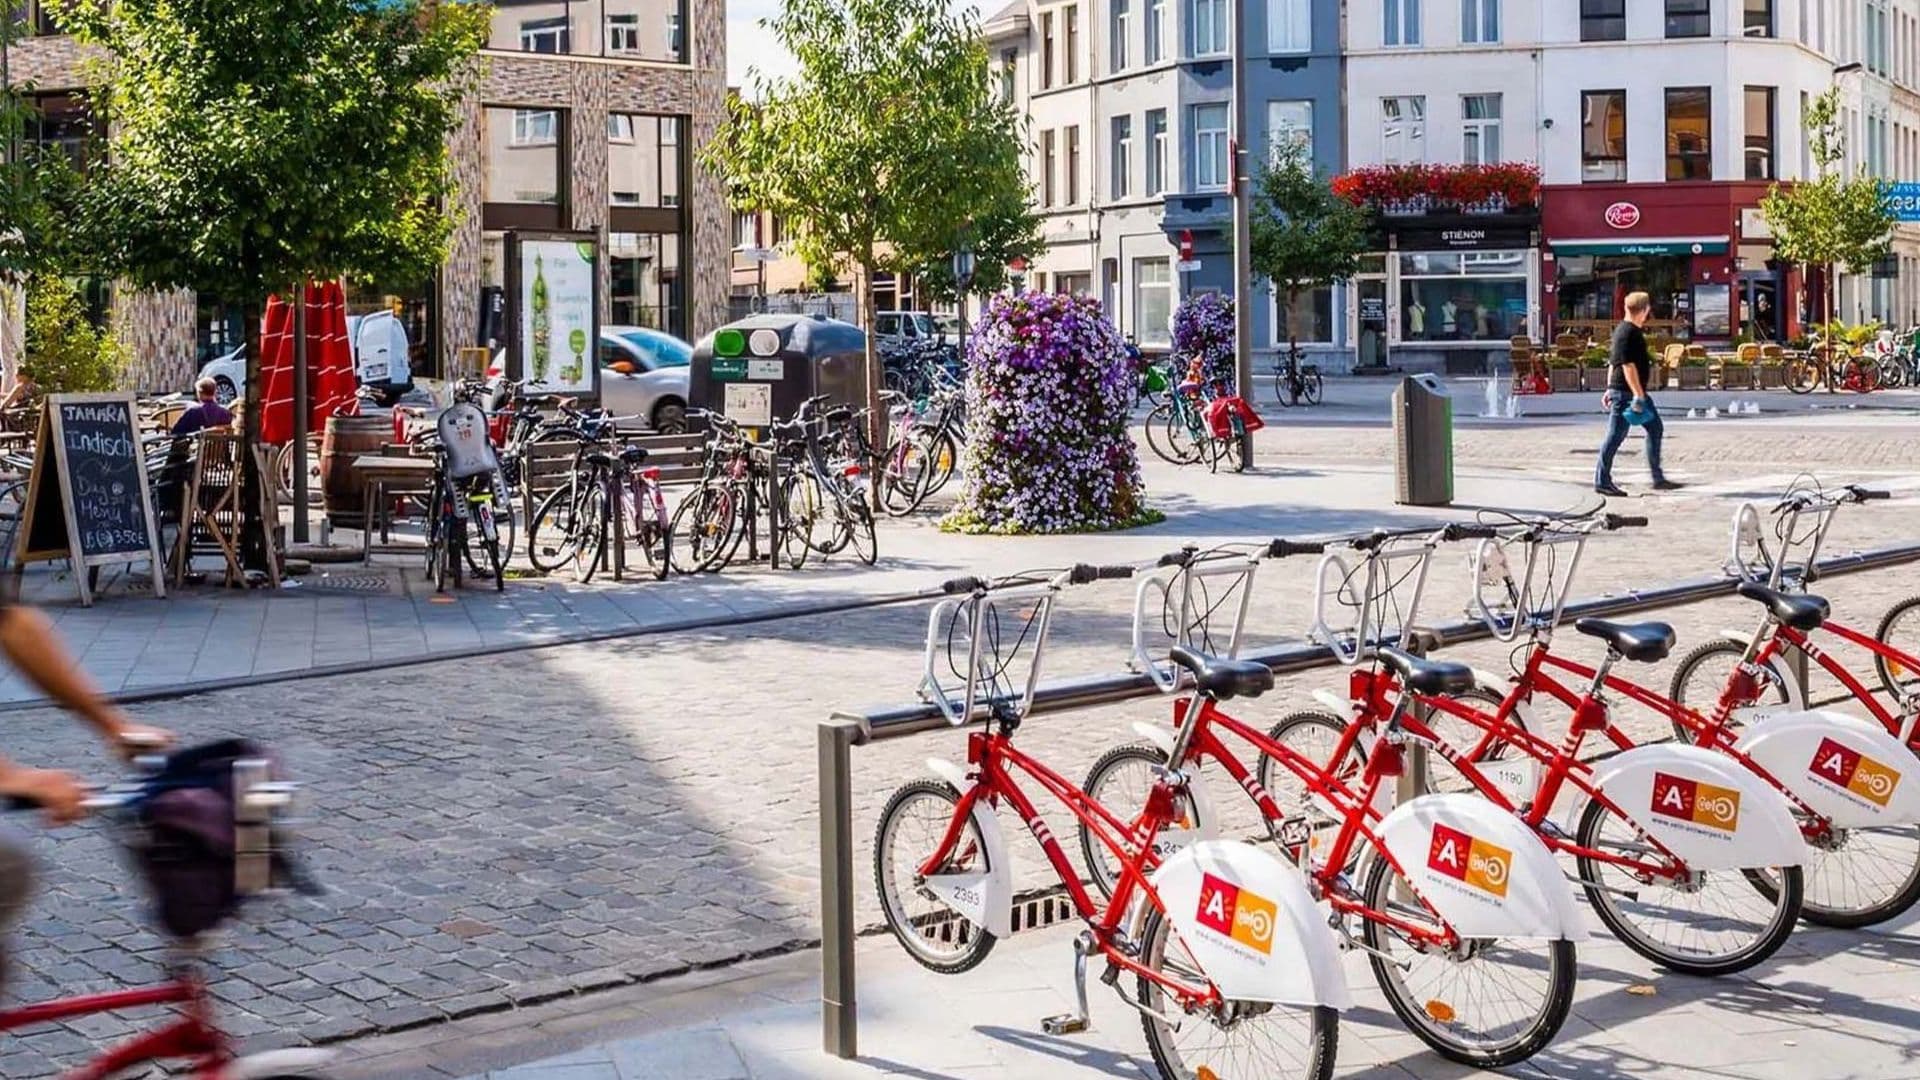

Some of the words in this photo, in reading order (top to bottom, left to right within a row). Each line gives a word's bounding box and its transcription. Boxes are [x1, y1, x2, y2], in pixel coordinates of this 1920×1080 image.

[1821, 752, 1842, 776] A
[1499, 770, 1523, 785] 1190
[1662, 785, 1684, 810] A
[1437, 838, 1458, 869] A
[953, 885, 980, 906] 2393
[1205, 889, 1225, 922] A
